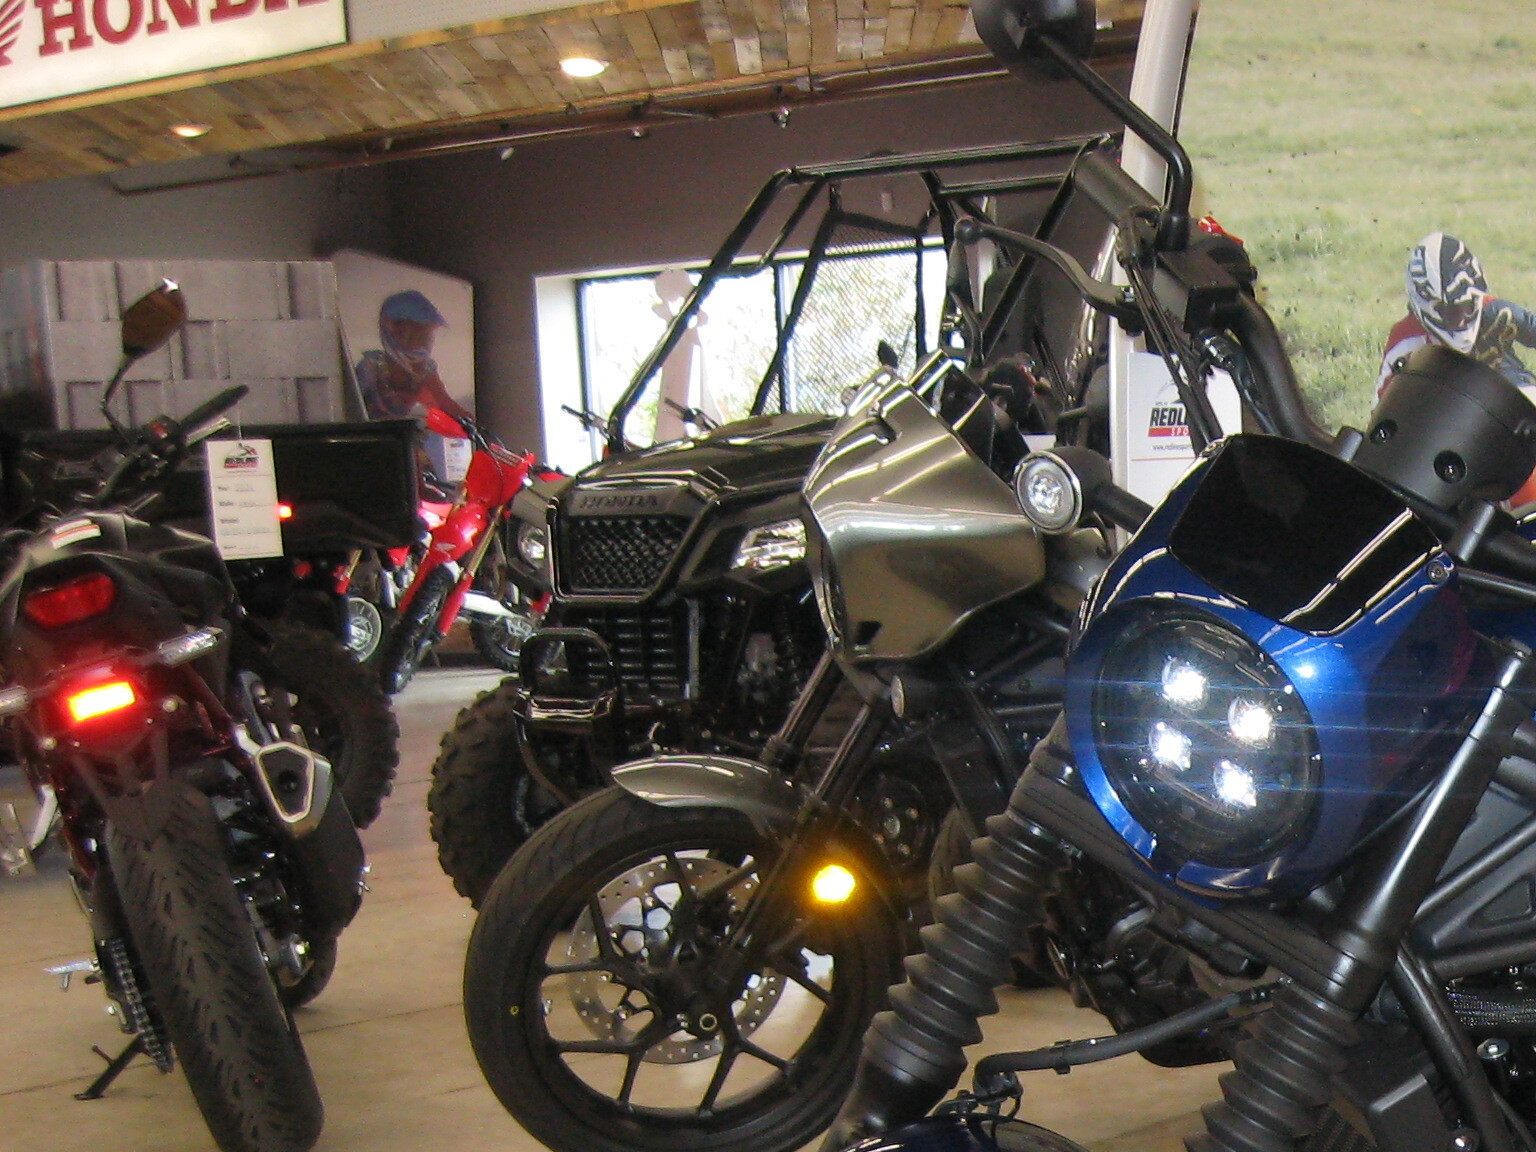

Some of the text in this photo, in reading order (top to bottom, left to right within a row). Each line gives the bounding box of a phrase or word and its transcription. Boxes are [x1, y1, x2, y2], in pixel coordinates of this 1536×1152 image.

[35, 0, 330, 57] HON
[1150, 407, 1187, 426] REDL
[1171, 427, 1190, 436] SPO
